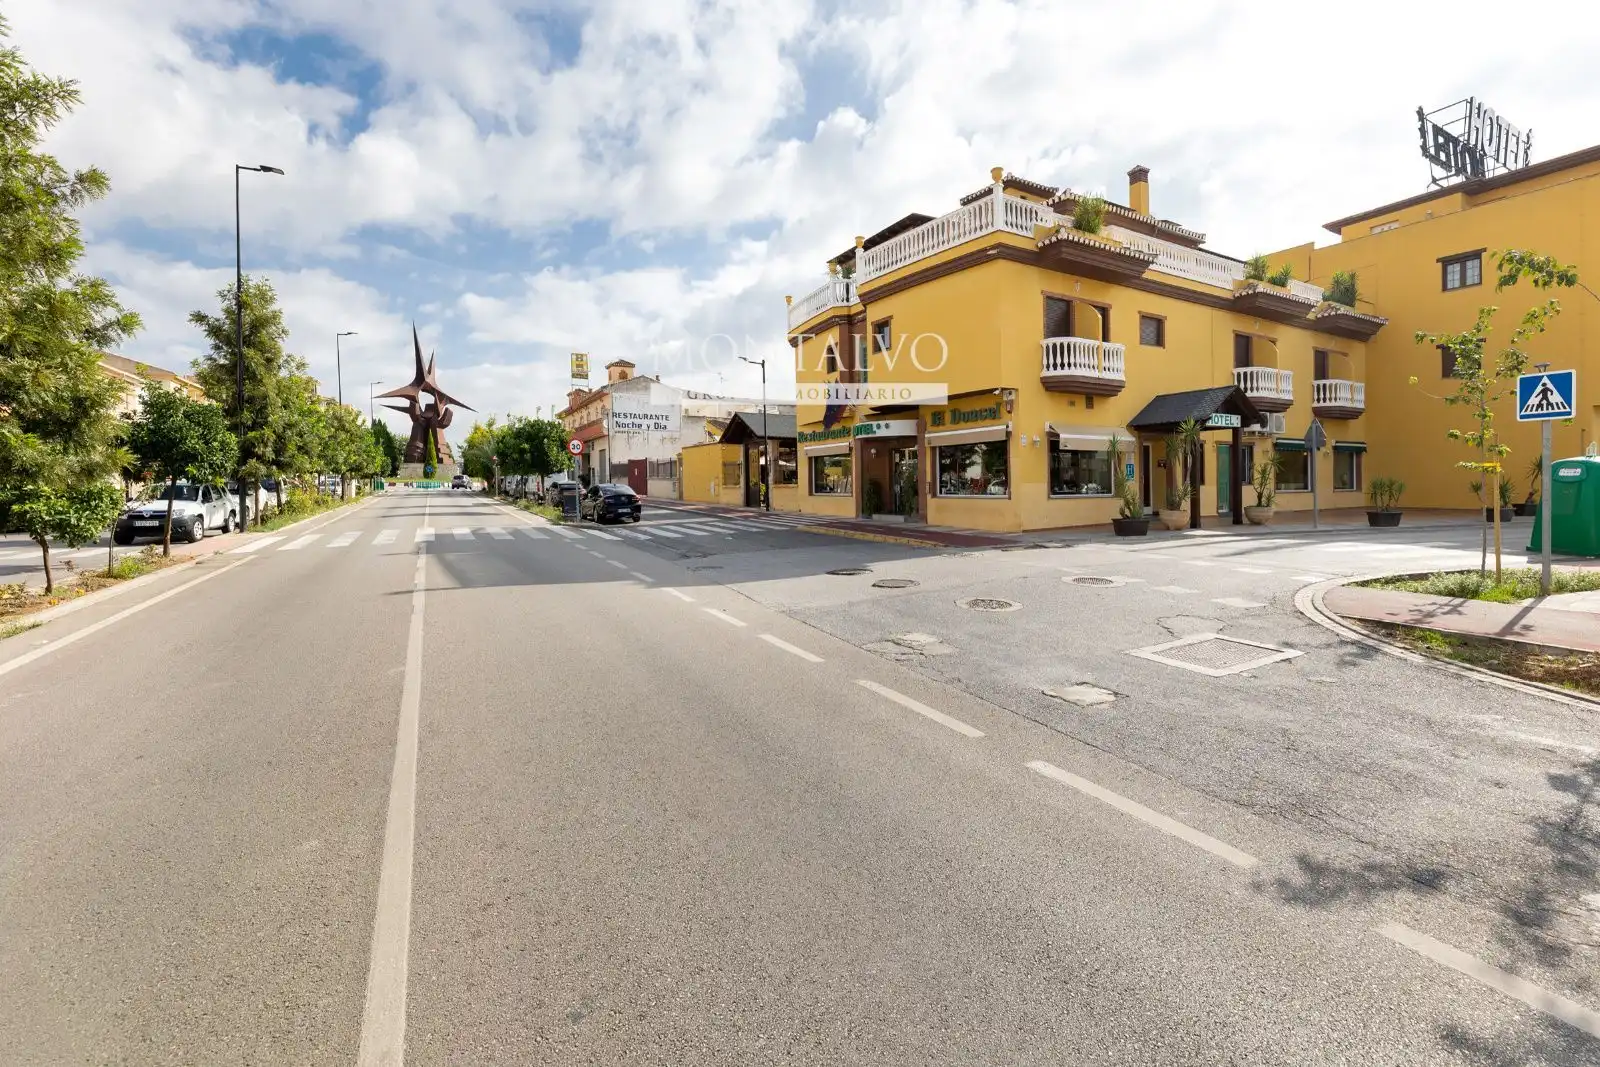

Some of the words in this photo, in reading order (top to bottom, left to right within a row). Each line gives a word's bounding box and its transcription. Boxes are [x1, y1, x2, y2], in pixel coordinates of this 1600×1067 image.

[613, 412, 670, 422] RESTAURANTE
[615, 421, 642, 429] Noche
[646, 423, 651, 431] y
[798, 427, 850, 443] Restaurante
